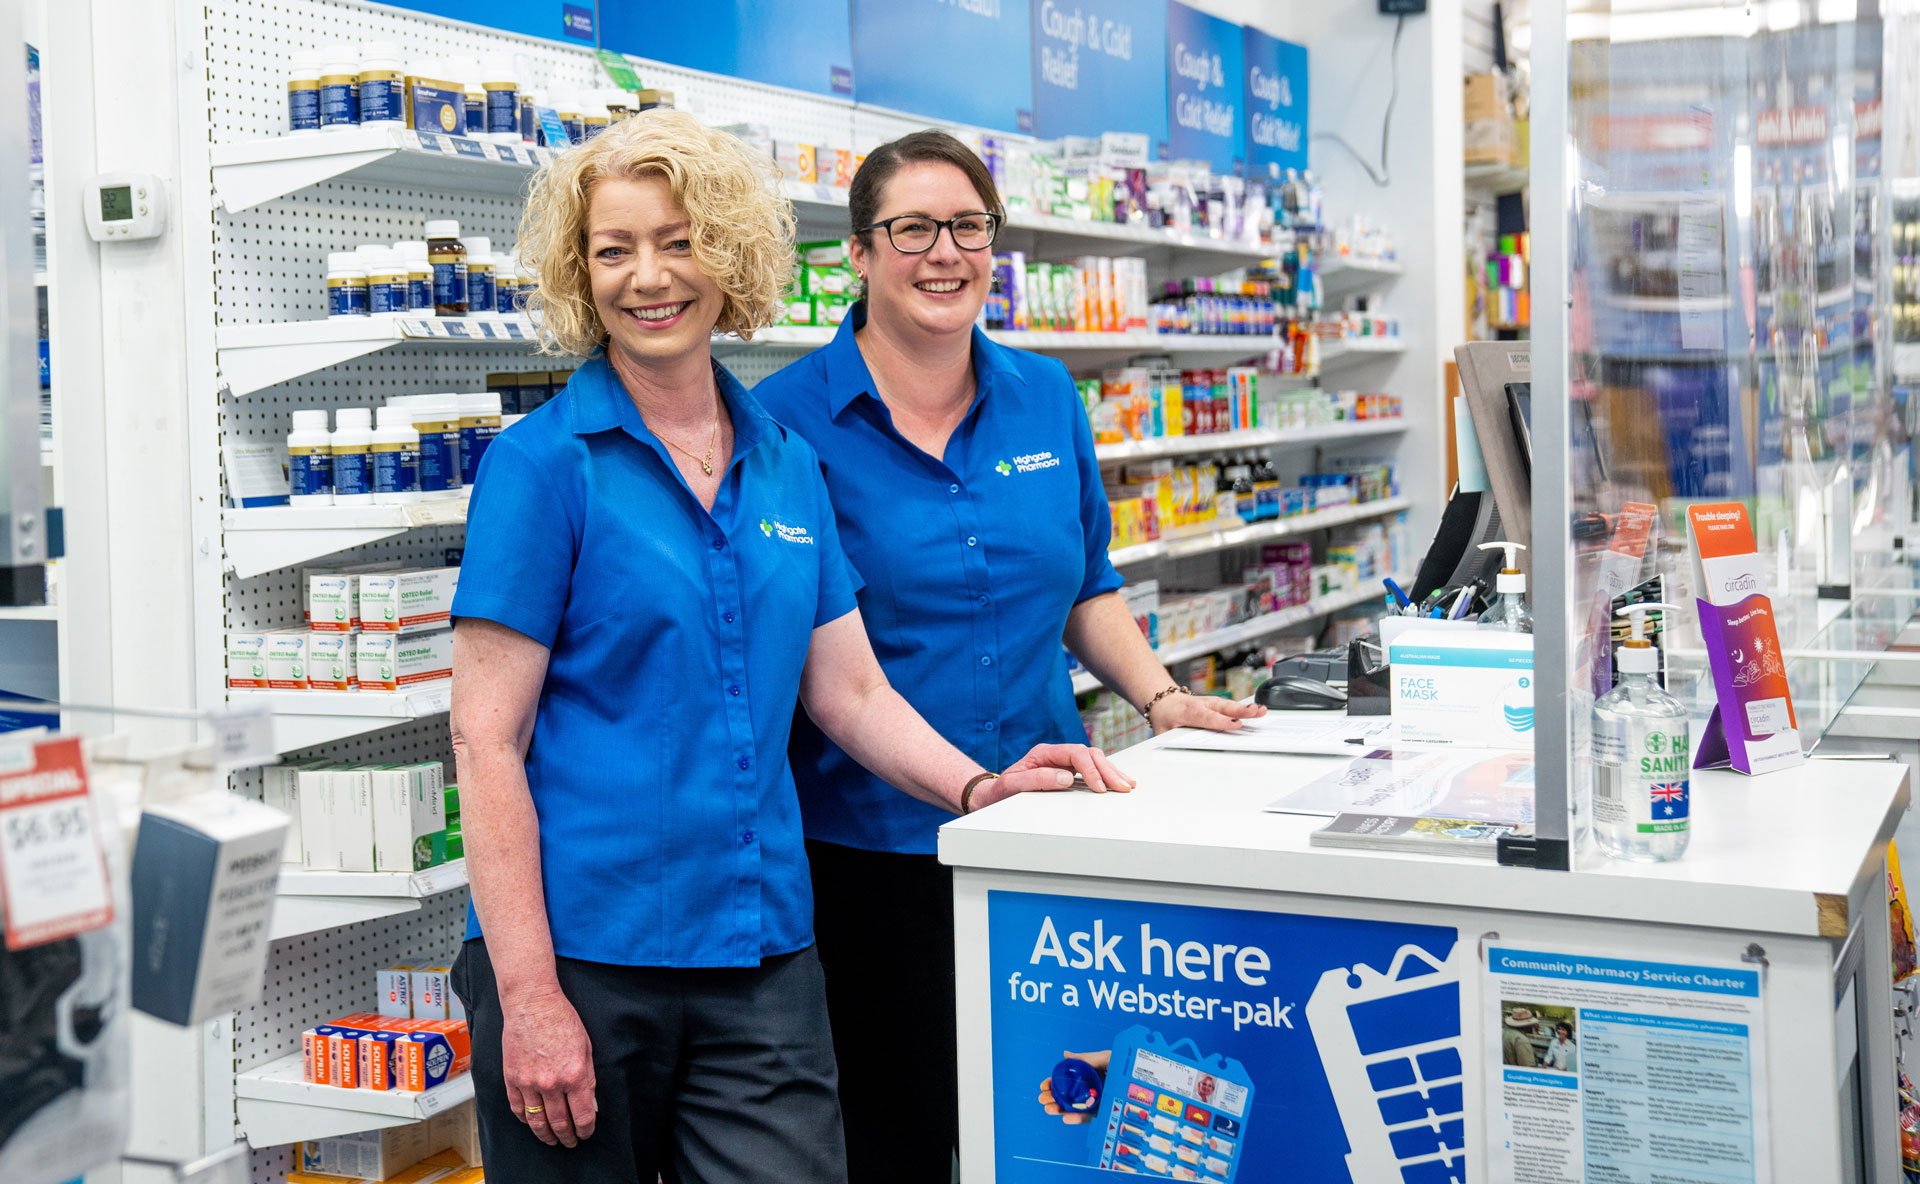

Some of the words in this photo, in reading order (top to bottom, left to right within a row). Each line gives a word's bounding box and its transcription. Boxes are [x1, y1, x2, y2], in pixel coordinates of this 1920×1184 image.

[1041, 0, 1086, 52] Cough
[1087, 15, 1101, 50] &
[1103, 20, 1132, 61] Cold
[1041, 46, 1079, 90] Relief
[1175, 42, 1210, 91] Cough
[1211, 53, 1225, 88] &
[1250, 65, 1279, 111] Cough
[1280, 75, 1293, 107] &
[1176, 92, 1202, 131] Cold
[1204, 100, 1234, 138] Relief
[1251, 111, 1275, 147] Cold
[1274, 117, 1301, 152] Relief
[1013, 451, 1052, 466] Highgate
[1016, 457, 1060, 473] Pharmacy
[774, 520, 807, 536] Highgate
[1694, 511, 1716, 522] Trouble
[1716, 510, 1741, 522] sleeping?
[778, 528, 814, 544] Pharmacy
[1724, 576, 1757, 593] circadin
[1727, 618, 1739, 626] Sleep
[1400, 678, 1434, 690] FACE
[1400, 688, 1438, 701] MASK
[1030, 916, 1126, 973] Ask
[1141, 922, 1271, 986] here
[1501, 956, 1573, 975] Community
[1576, 964, 1640, 981] Pharmacy
[1642, 970, 1691, 984] Service
[1694, 975, 1746, 989] Charter
[434, 976, 442, 1007] ASTRIX
[1008, 972, 1052, 1004] for
[1062, 984, 1080, 1007] a
[316, 1040, 324, 1081] SOLPRIN
[409, 1046, 417, 1087] SOLPRIN
